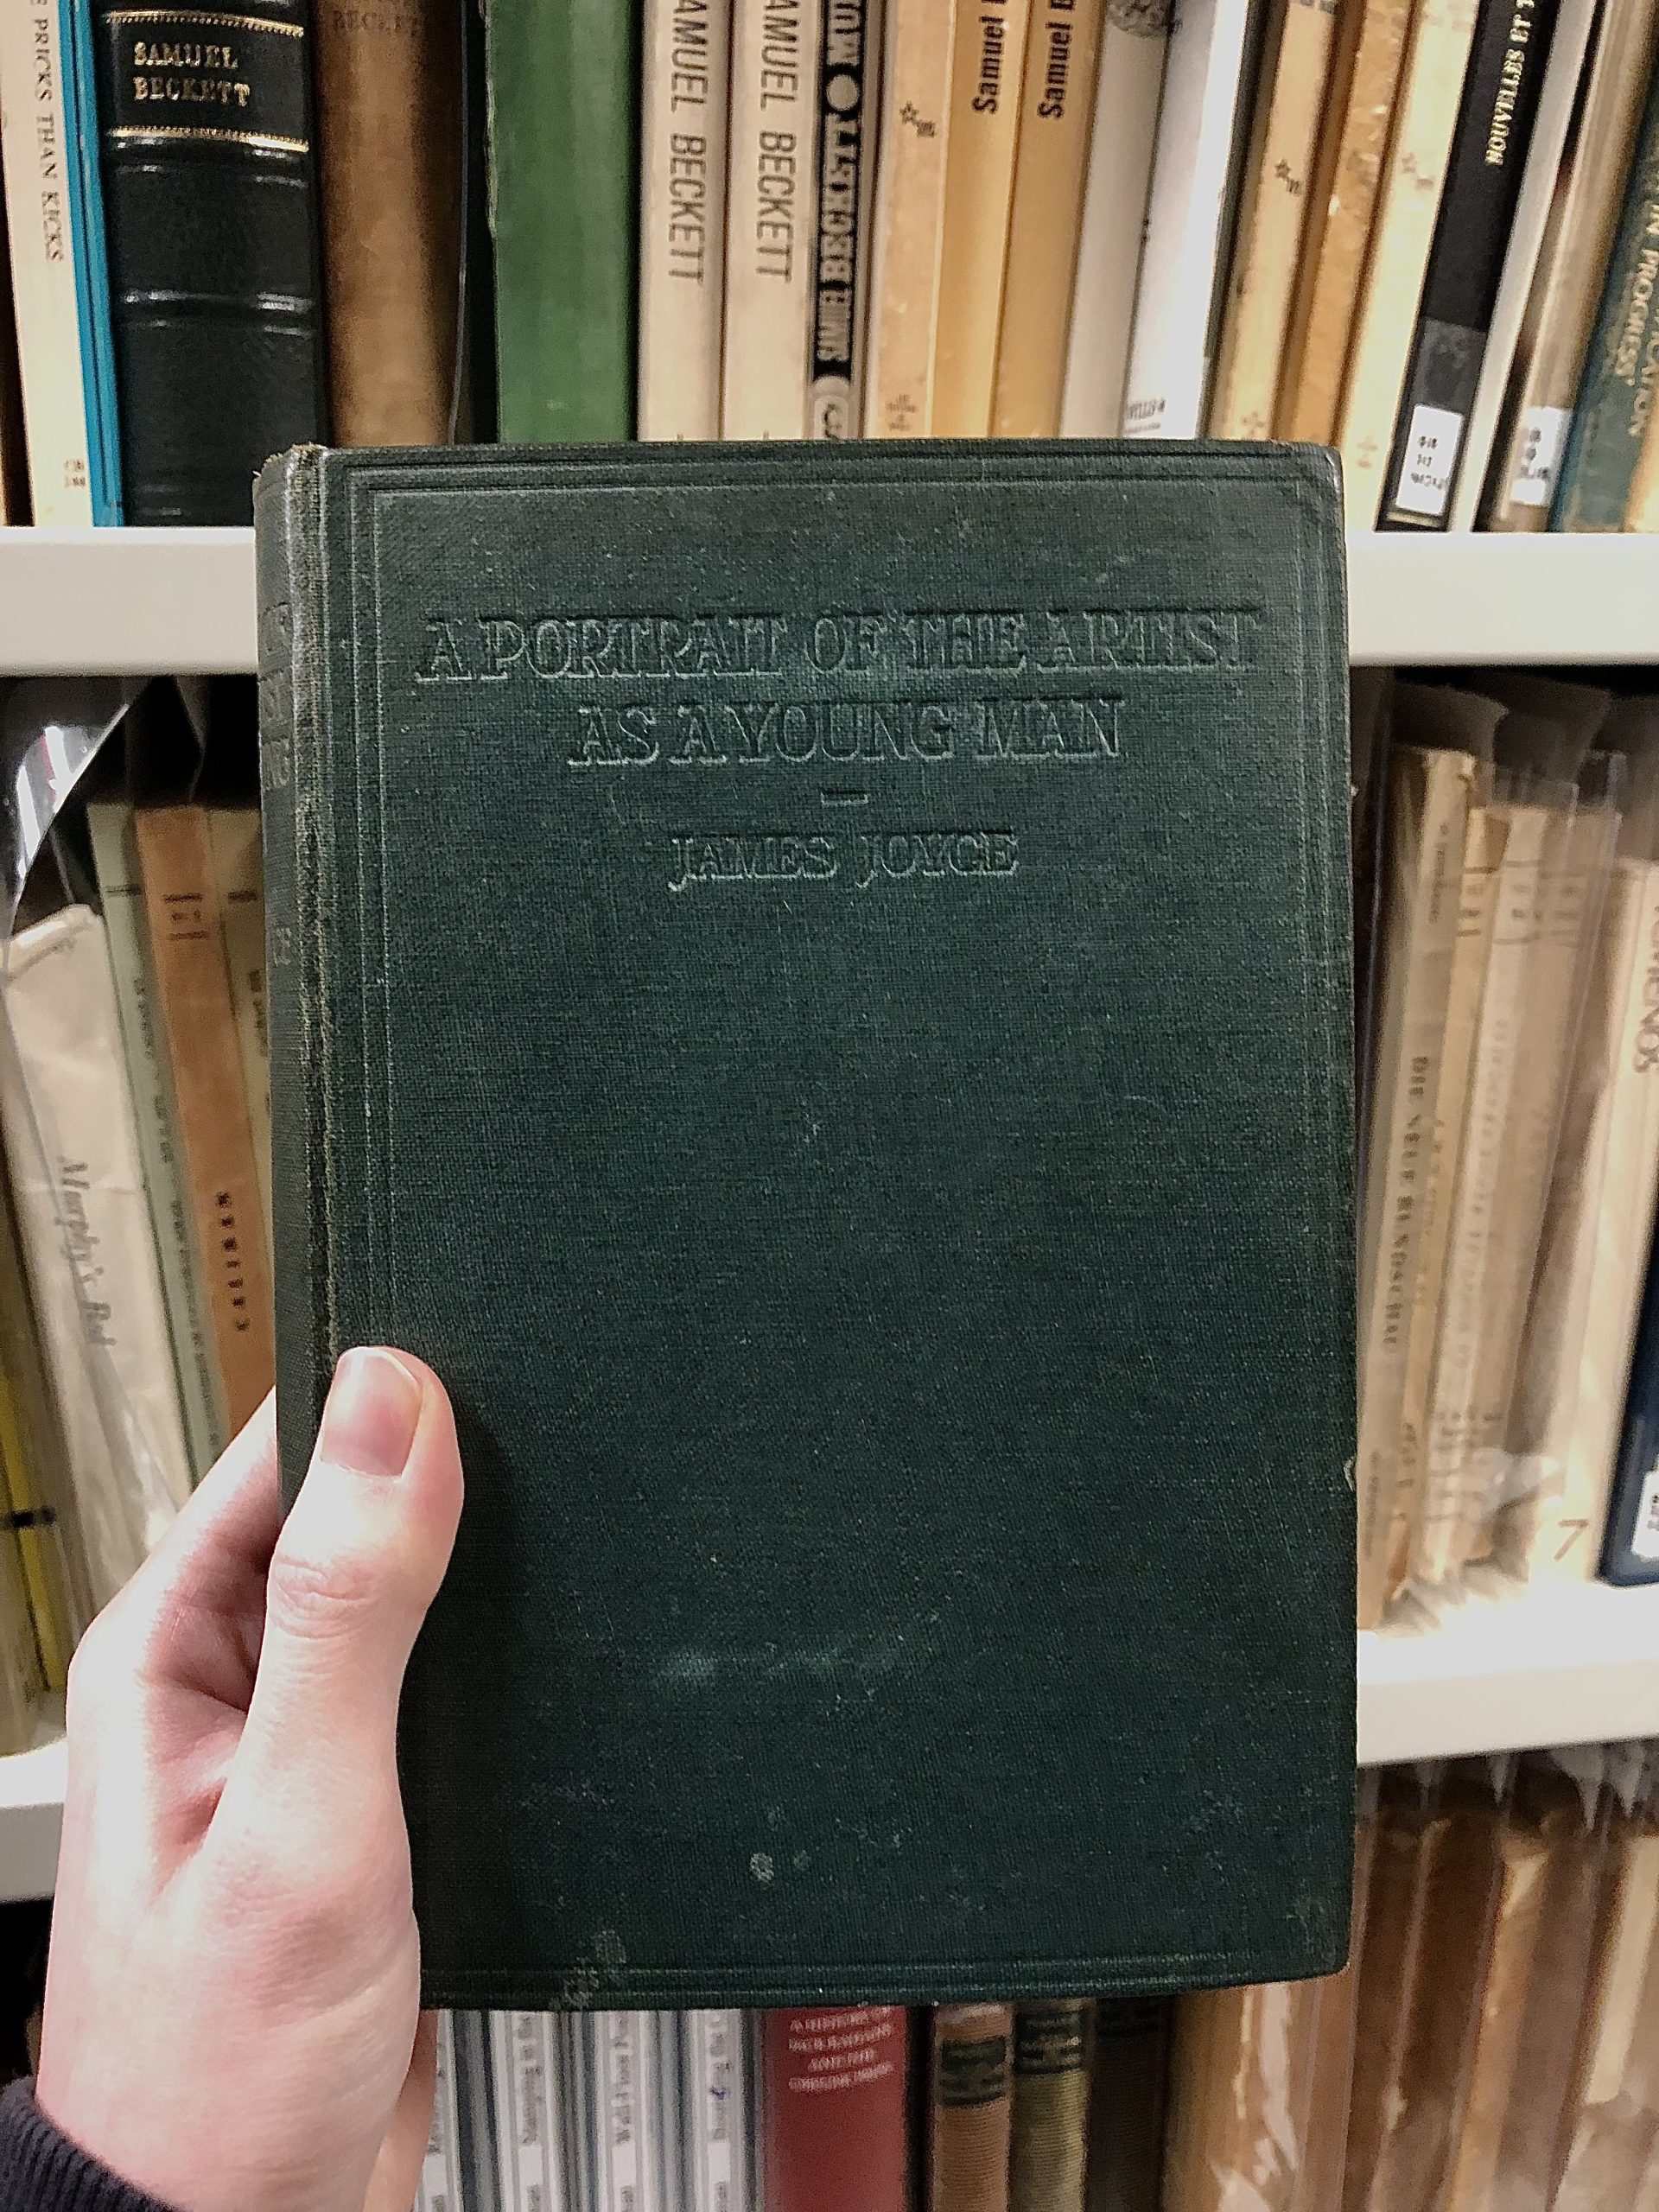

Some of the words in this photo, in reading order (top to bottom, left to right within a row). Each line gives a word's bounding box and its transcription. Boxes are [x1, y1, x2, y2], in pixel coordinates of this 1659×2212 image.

[34, 18, 53, 101] PRICKS
[133, 75, 251, 107] BECKETT
[134, 41, 239, 70] SAMUEL
[972, 16, 1005, 114] Samuel
[1037, 21, 1072, 118] Samuel
[35, 111, 57, 179] THAN
[41, 190, 64, 262] KICKS
[668, 132, 707, 286] BECKETT
[755, 130, 797, 283] BECKETT
[416, 615, 473, 683] A
[479, 613, 788, 683] PORTRAIT
[804, 610, 885, 674] OF
[902, 608, 1026, 674] THE
[1036, 607, 1262, 673] ARTIST
[567, 702, 659, 766] AS
[668, 702, 727, 766] A
[723, 700, 952, 764] YOUNG
[973, 697, 1124, 761] MAN
[667, 833, 837, 893] JAMES
[855, 830, 1019, 890] JOYCE
